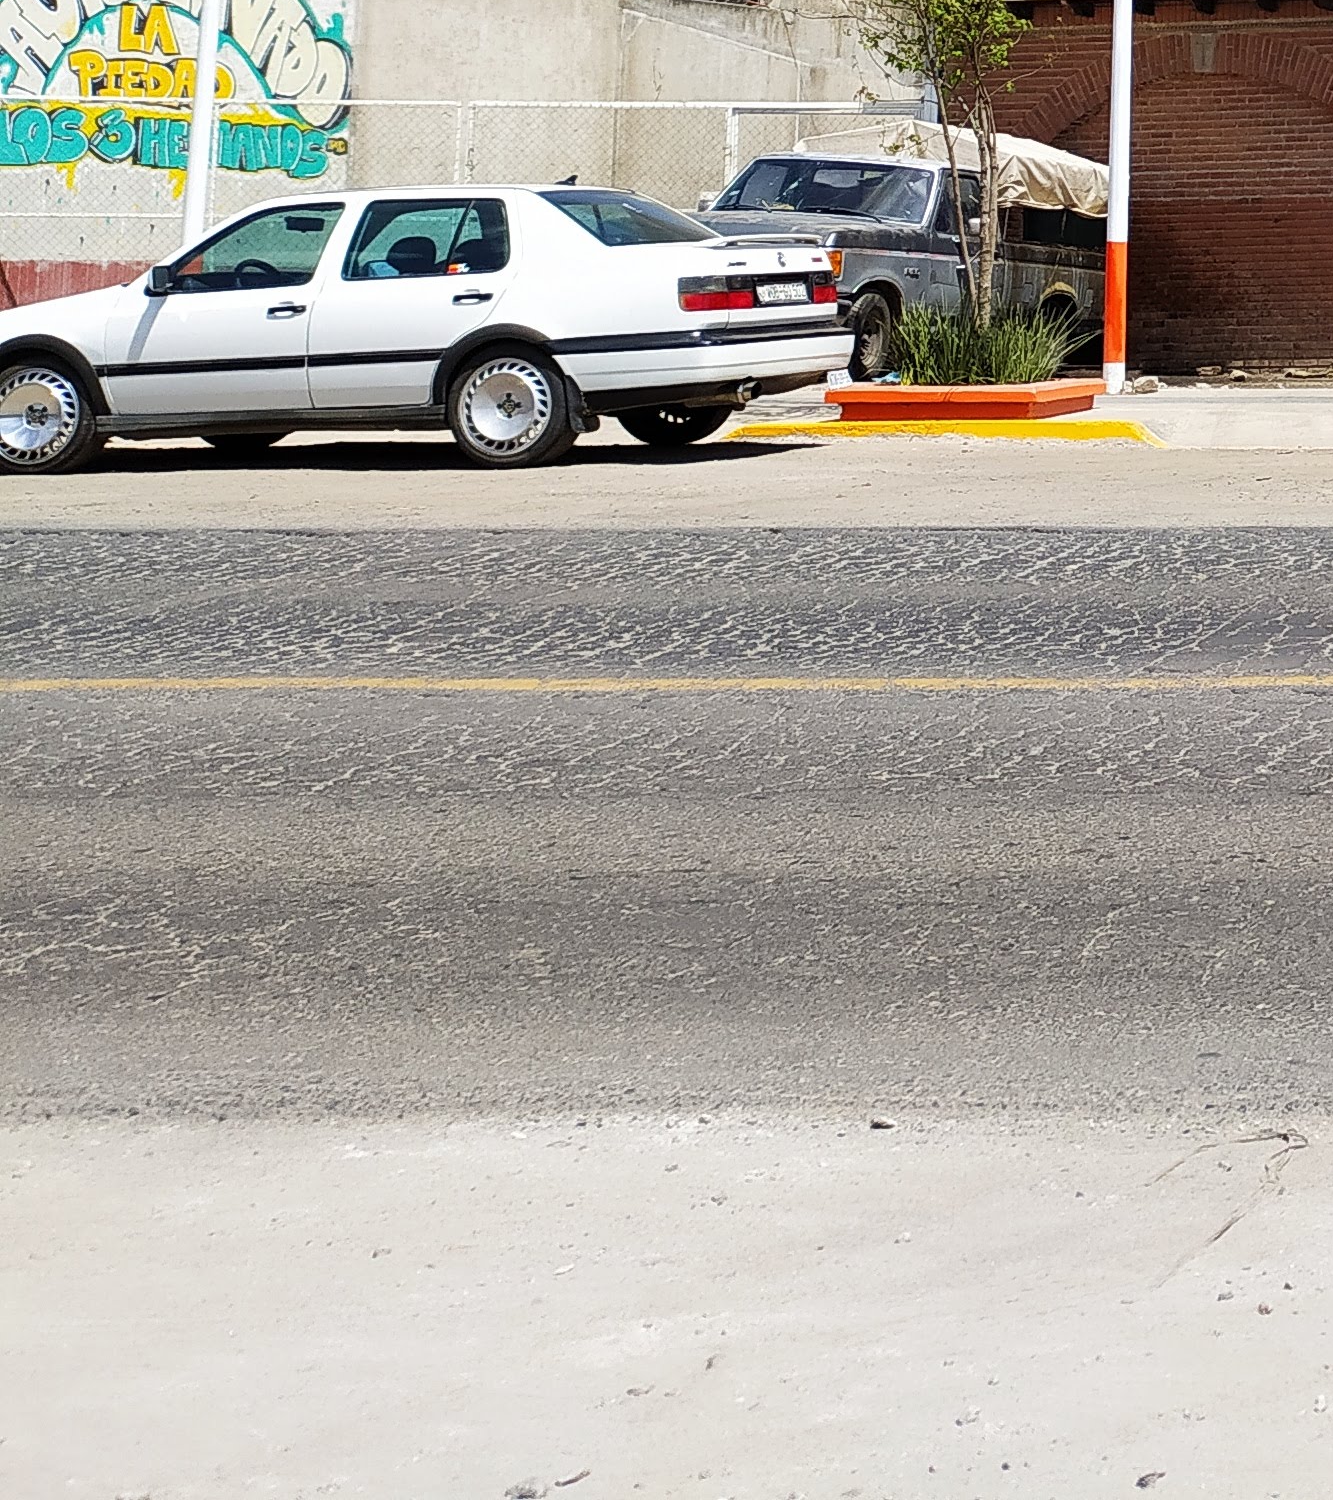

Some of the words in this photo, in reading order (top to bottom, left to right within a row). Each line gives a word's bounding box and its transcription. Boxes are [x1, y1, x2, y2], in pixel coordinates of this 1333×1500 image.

[118, 2, 181, 56] LA
[68, 50, 236, 100] PIEDAD
[89, 108, 137, 164] 3
[136, 116, 329, 180] HEANOS
